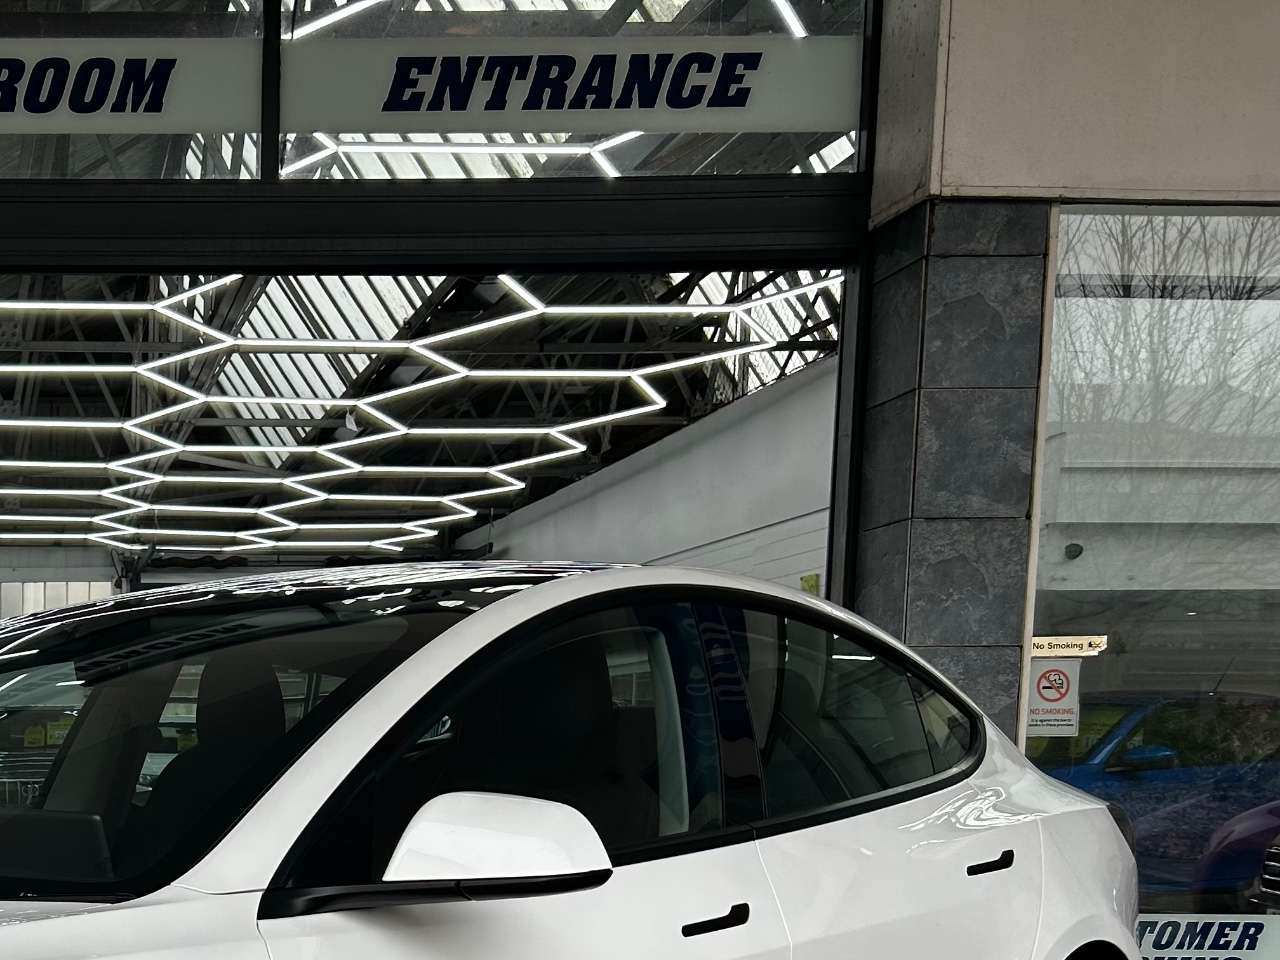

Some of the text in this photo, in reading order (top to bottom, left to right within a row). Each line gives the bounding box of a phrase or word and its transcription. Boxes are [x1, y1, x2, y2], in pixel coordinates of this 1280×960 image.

[381, 52, 763, 112] ENTRANCE
[1032, 641, 1084, 651] No Smoking
[1029, 707, 1040, 716] NO
